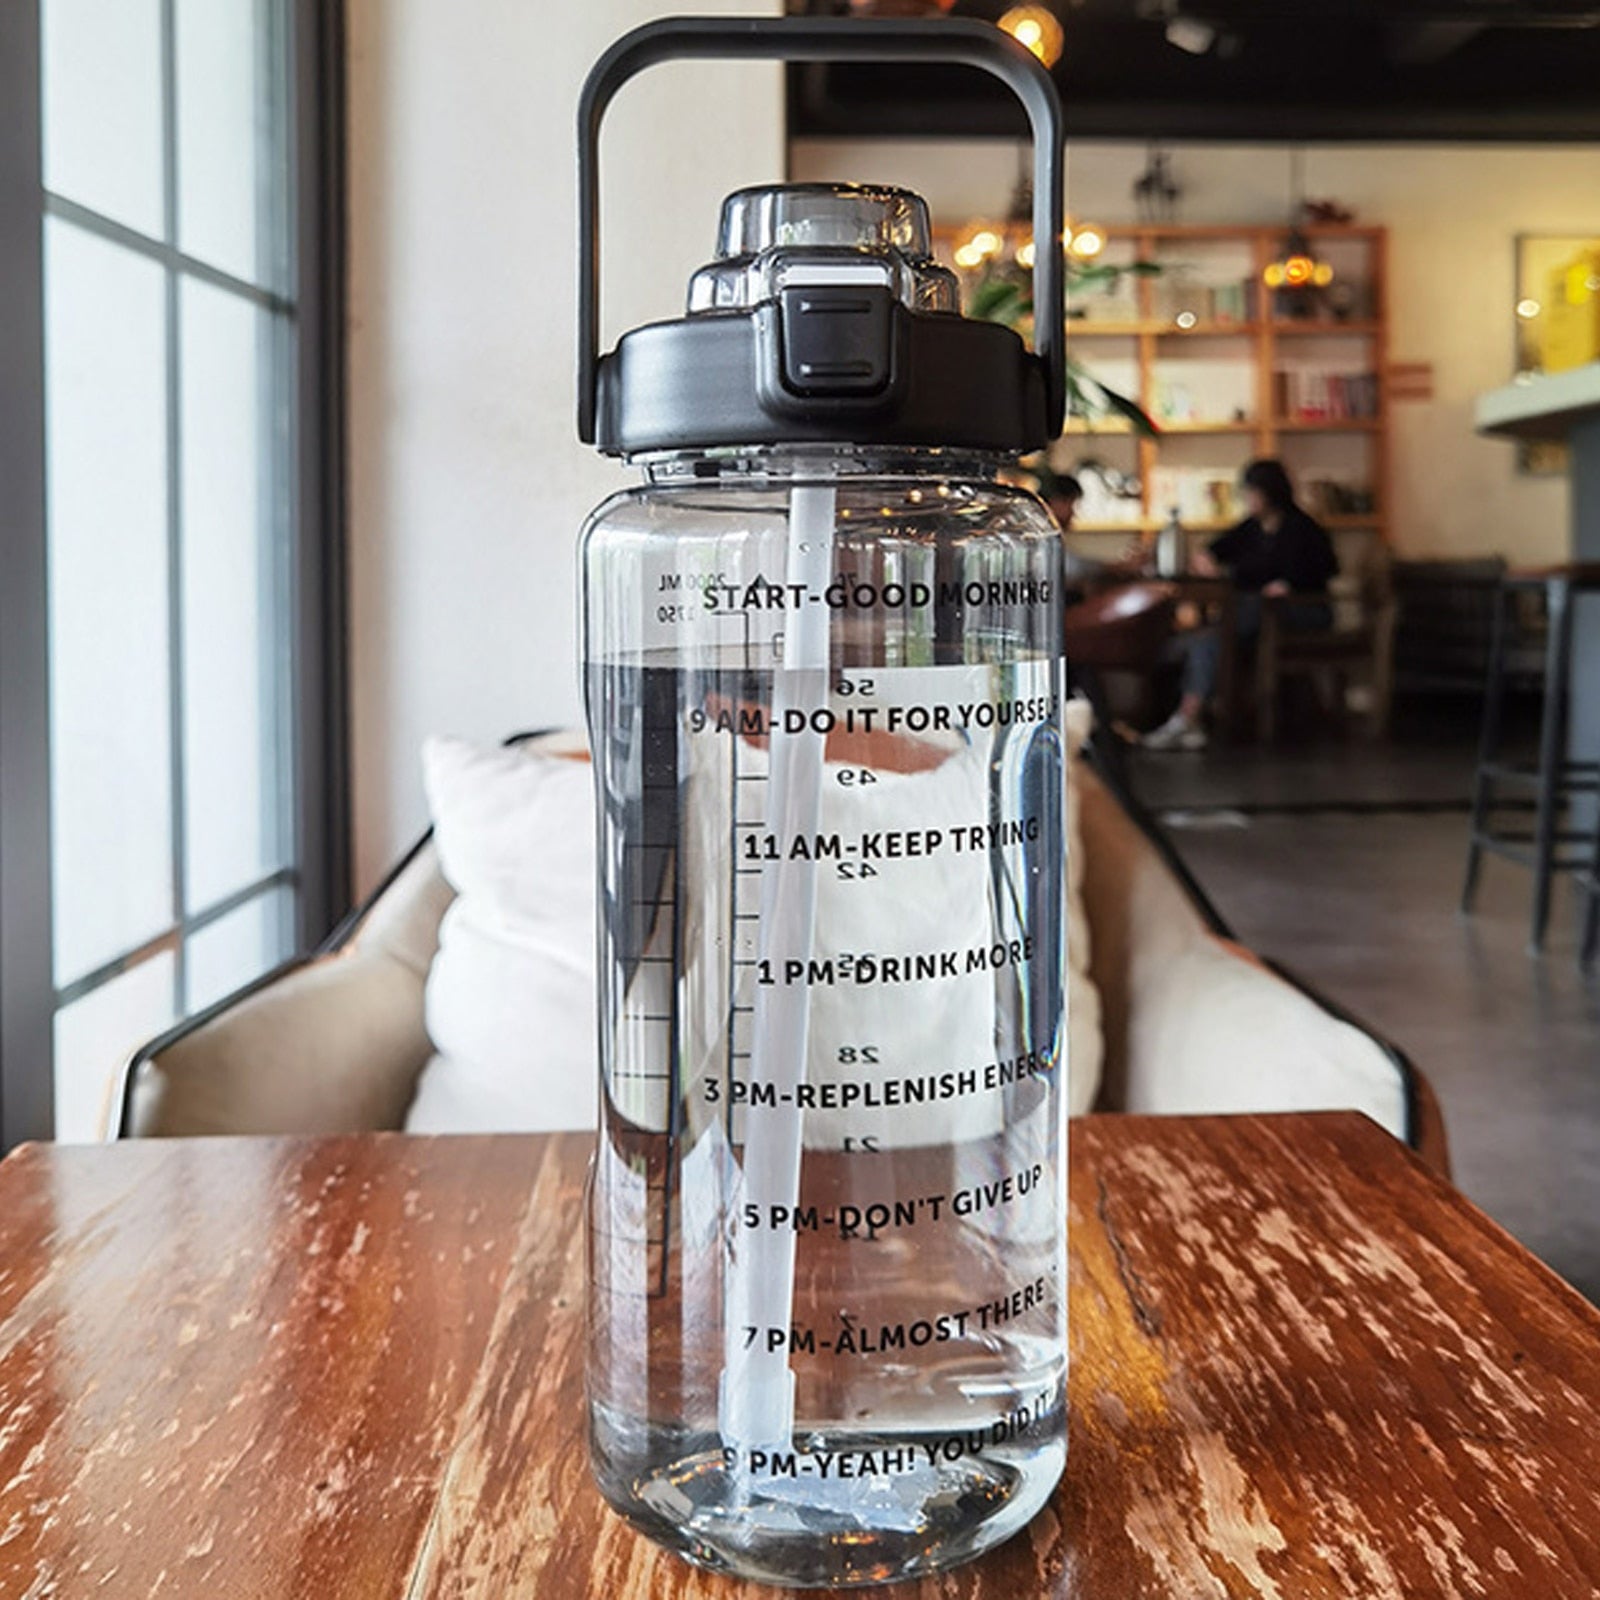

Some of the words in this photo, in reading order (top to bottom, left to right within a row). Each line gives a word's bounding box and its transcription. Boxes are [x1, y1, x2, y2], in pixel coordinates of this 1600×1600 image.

[703, 583, 930, 610] START-GOOD
[690, 709, 706, 734] 9
[715, 708, 836, 735] AM-DO
[847, 708, 879, 734] IT
[888, 705, 950, 733] FOR
[744, 833, 780, 861] 11
[789, 829, 943, 861] AM-KEEP
[949, 816, 1039, 853] TRYING
[758, 960, 775, 985] 1
[785, 951, 958, 986] PM-DRINK
[965, 936, 1033, 974] MORE
[704, 1077, 720, 1103] 3
[730, 1069, 976, 1108] PM-REPLENISH
[744, 1203, 760, 1230] 5
[769, 1196, 945, 1232] PM-DON'T
[953, 1177, 1013, 1217] GIVE
[1018, 1163, 1043, 1196] UP
[743, 1326, 758, 1351] 7
[767, 1311, 971, 1356] PM-ALMOST
[975, 1276, 1045, 1331] THERE
[722, 1446, 737, 1472] 9
[750, 1446, 915, 1479] PM-YEAH!
[923, 1432, 985, 1468] YOU
[992, 1406, 1031, 1447] DID
